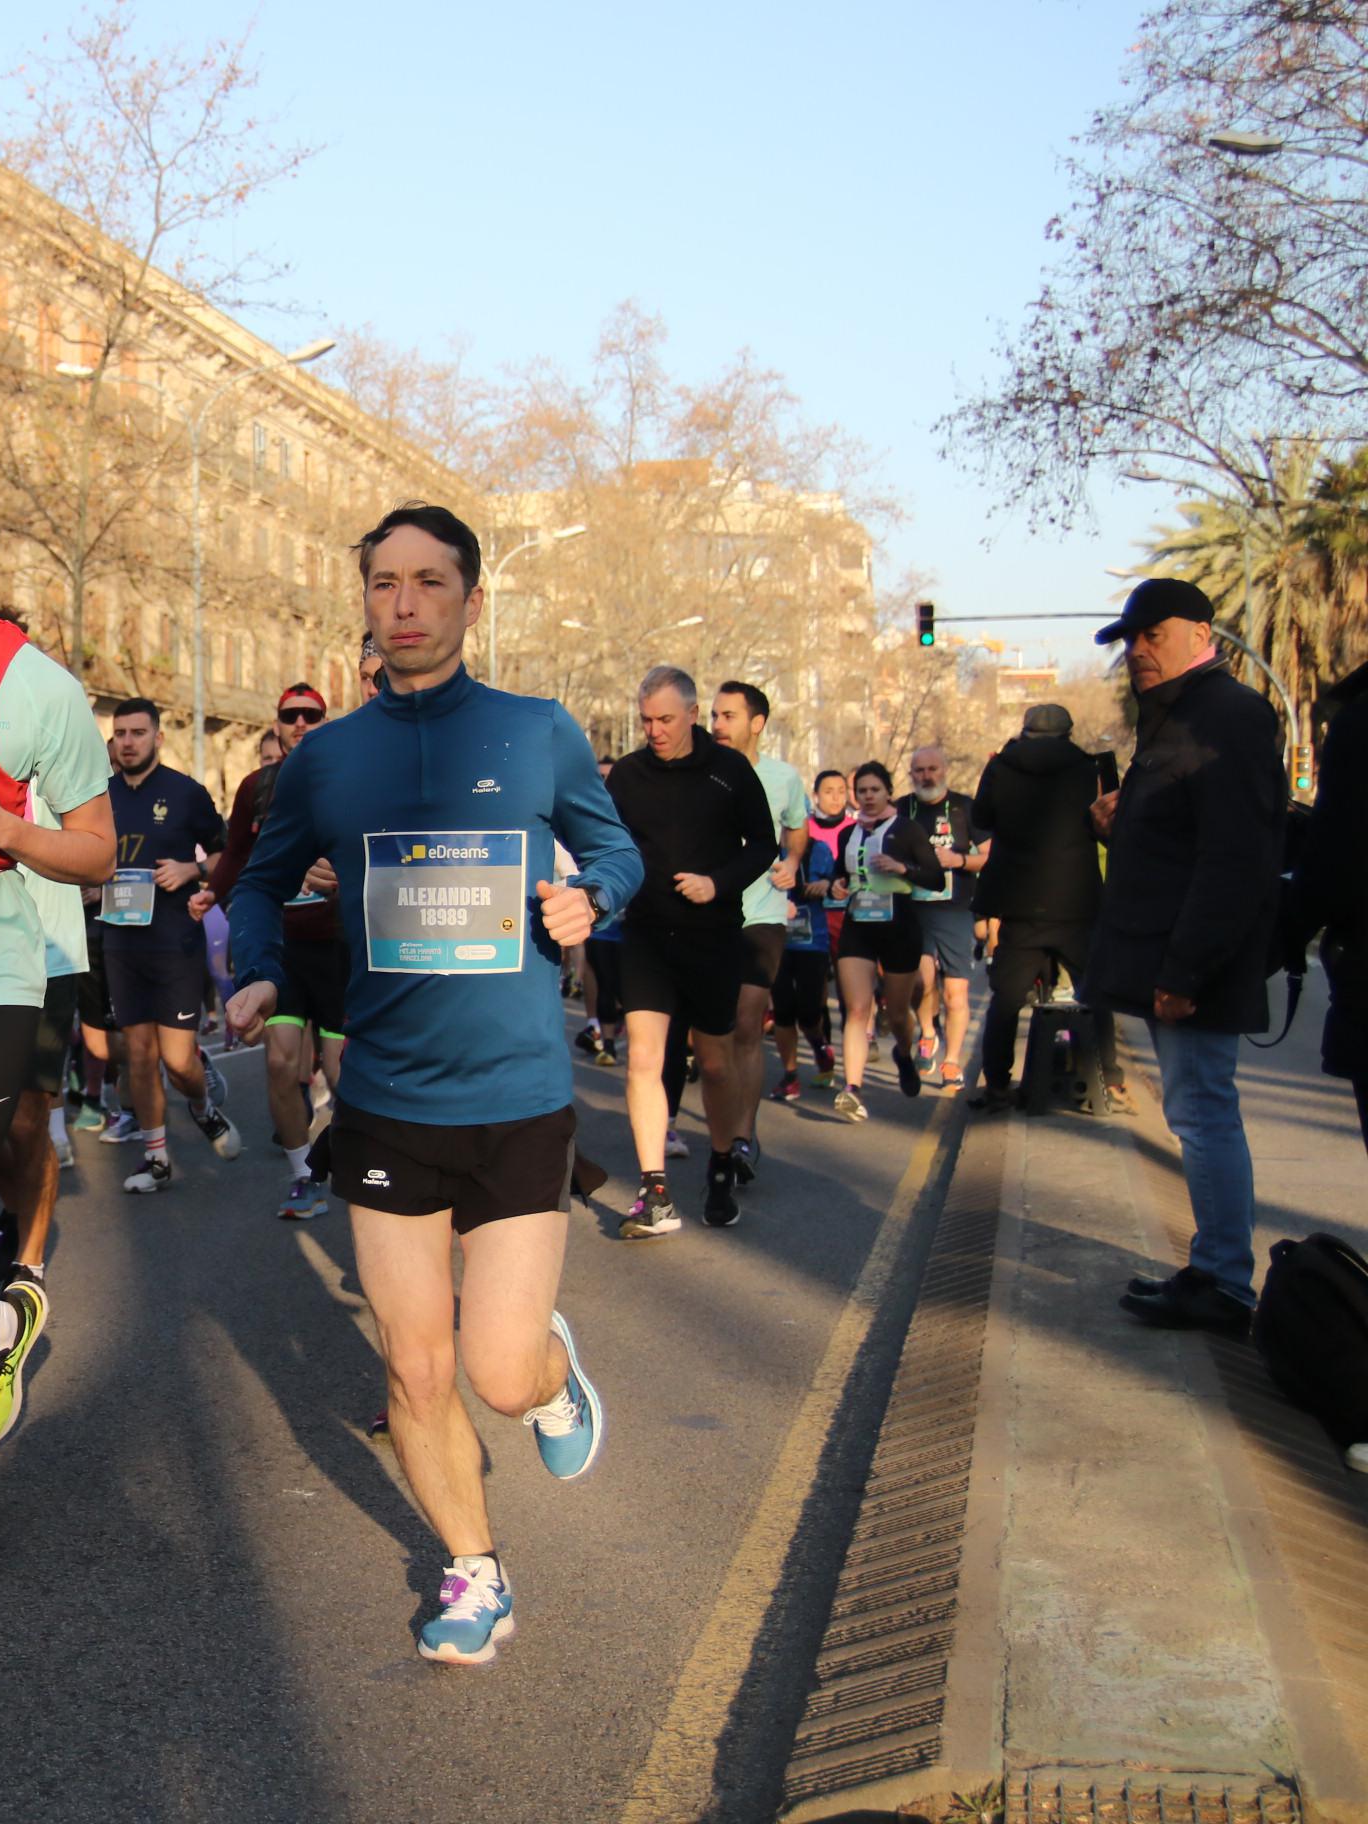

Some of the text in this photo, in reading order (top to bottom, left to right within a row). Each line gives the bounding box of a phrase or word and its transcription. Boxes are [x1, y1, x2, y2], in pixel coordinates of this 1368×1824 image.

[119, 834, 145, 862] 17
[428, 844, 489, 859] eDreams
[397, 887, 491, 906] ALEXANDER
[420, 908, 468, 926] 18989
